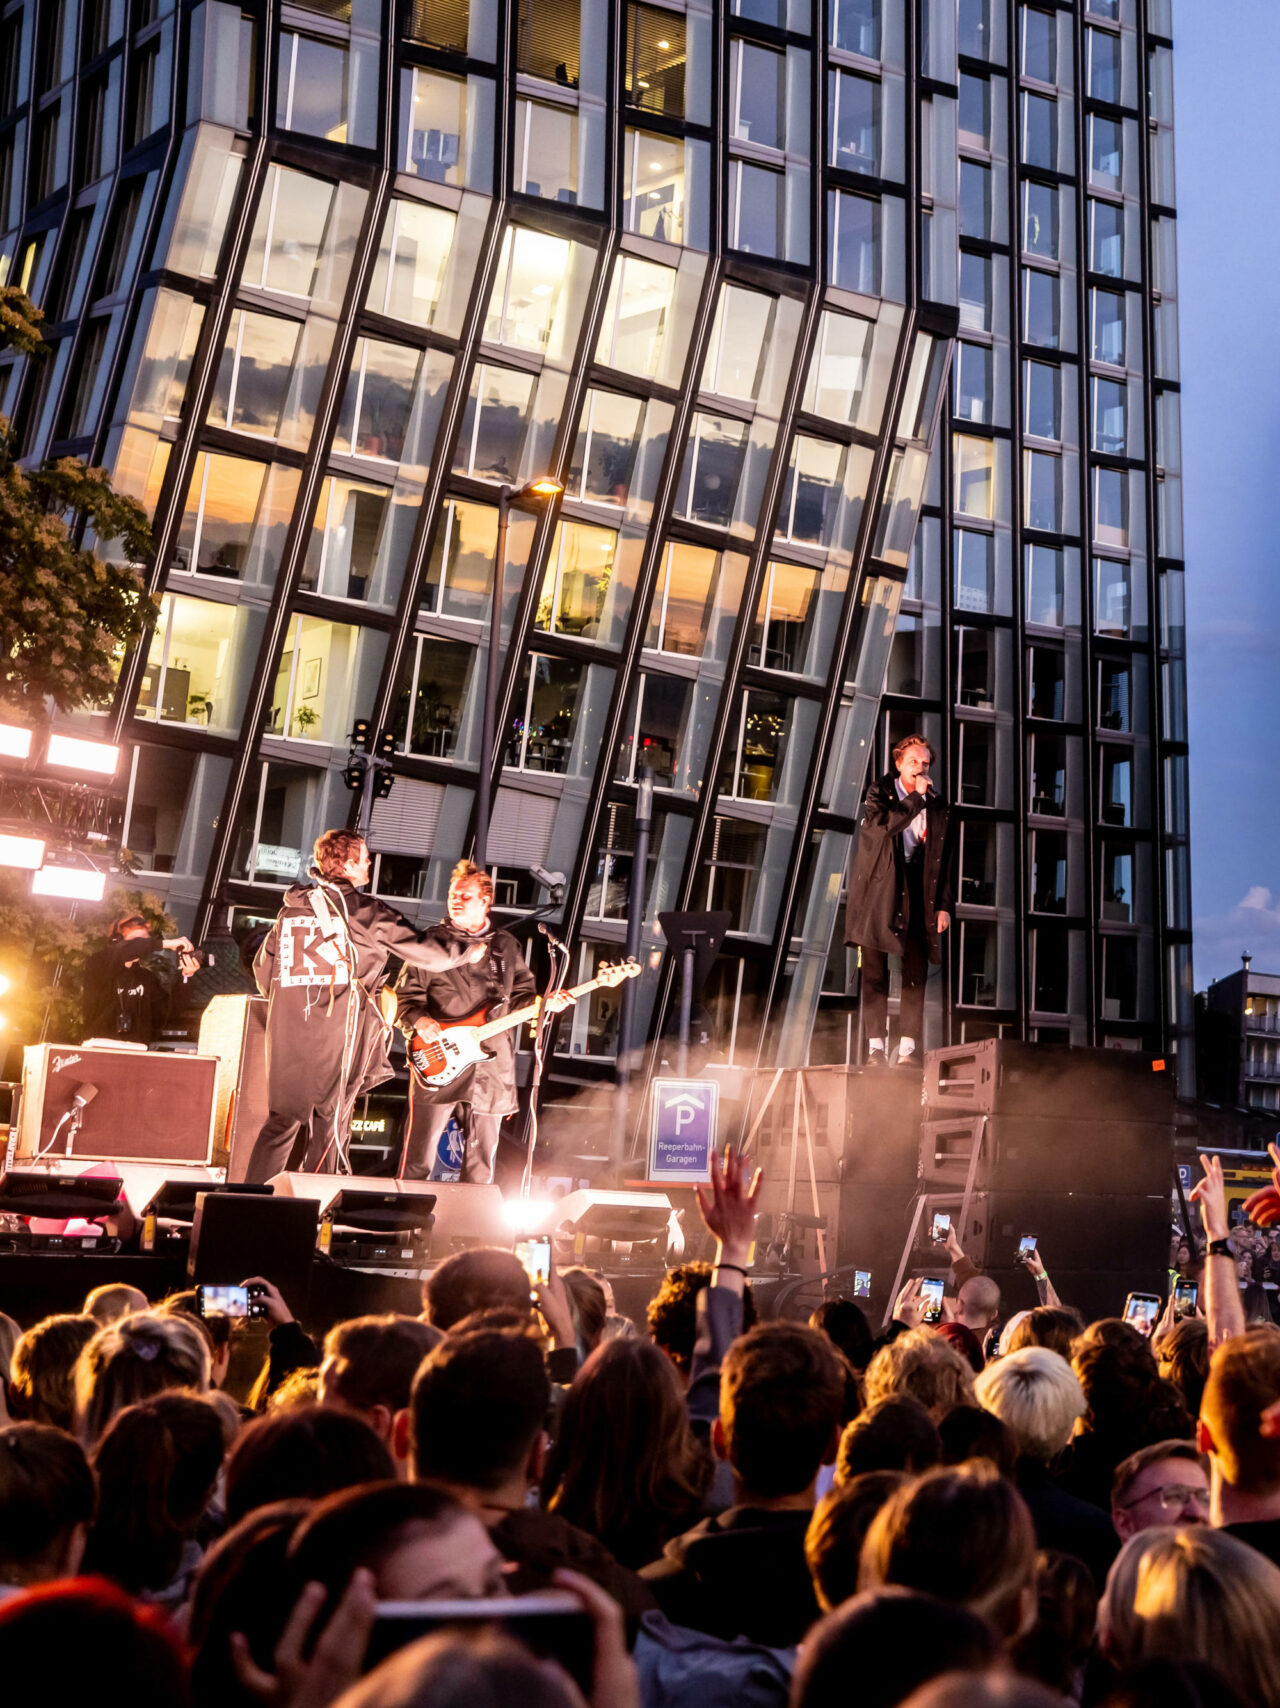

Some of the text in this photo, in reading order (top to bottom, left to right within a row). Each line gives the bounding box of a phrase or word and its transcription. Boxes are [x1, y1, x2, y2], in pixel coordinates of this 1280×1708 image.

[675, 1105, 695, 1136] P
[658, 1141, 706, 1153] Reeperbahn-
[665, 1154, 698, 1166] Garagen
